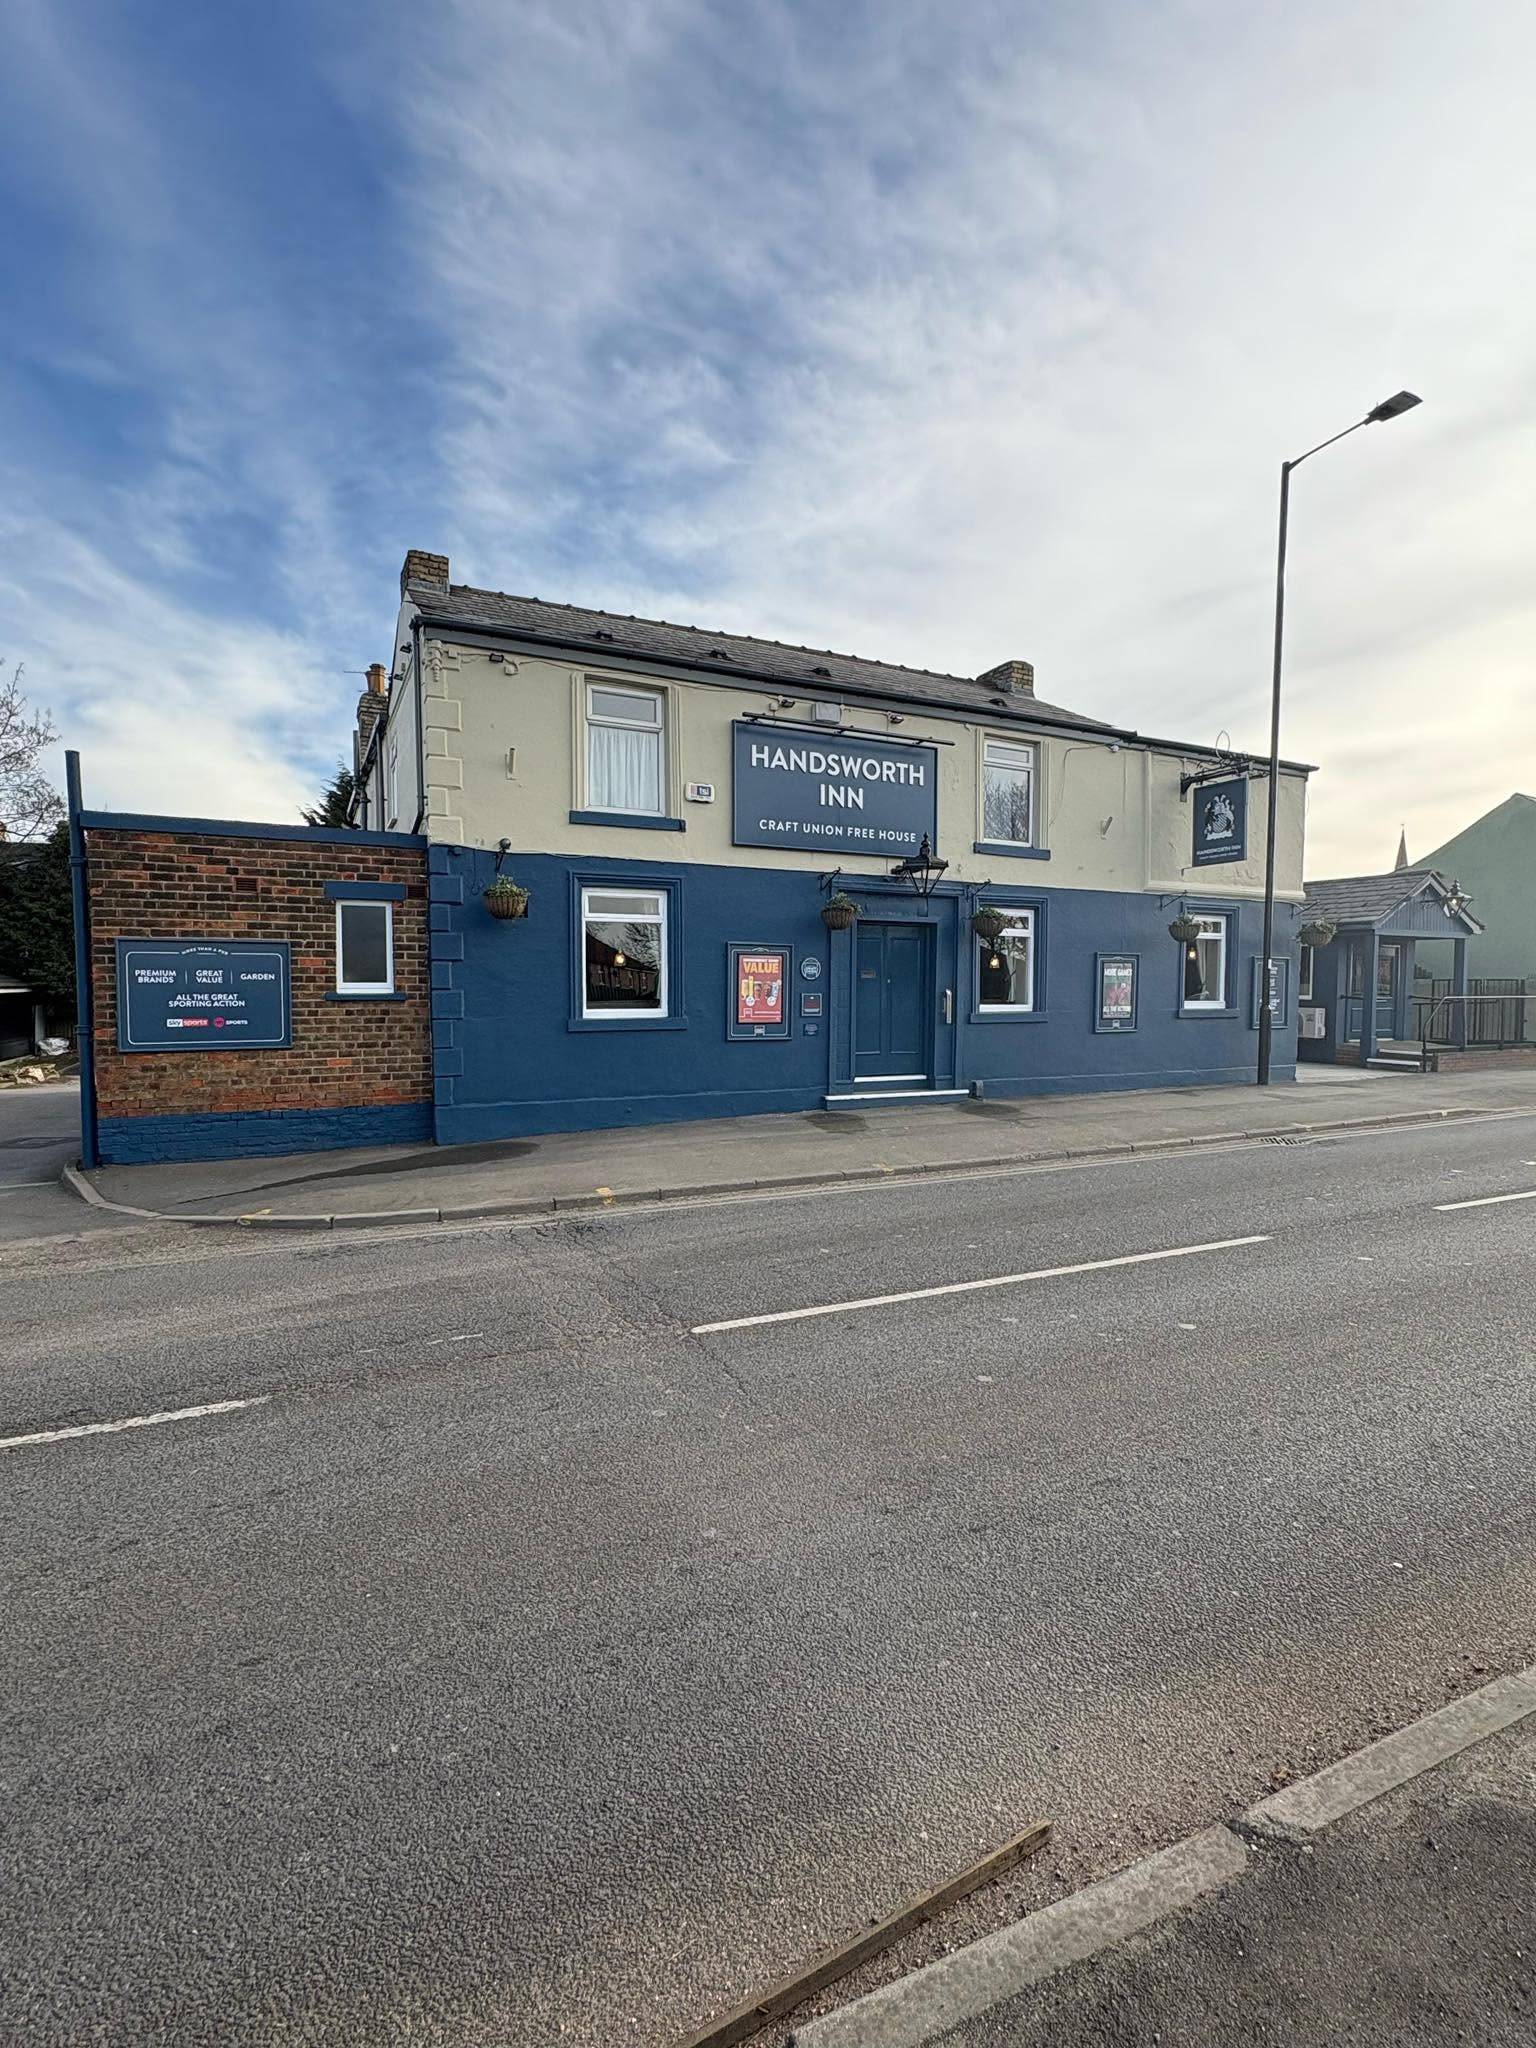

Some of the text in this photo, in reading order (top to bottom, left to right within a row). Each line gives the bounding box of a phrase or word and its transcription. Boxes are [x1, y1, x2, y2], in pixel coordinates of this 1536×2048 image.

[751, 744, 925, 786] HANDSWORTH
[820, 783, 864, 810] INN
[759, 819, 917, 843] CRAFT UNION FREE HOUSE
[744, 962, 779, 974] VALUE
[138, 976, 175, 984] BRANDS
[196, 976, 223, 984] VALUE
[240, 973, 275, 981] GARDEN
[211, 993, 238, 1001] GREAT
[168, 1000, 211, 1008] SPORTING
[168, 1019, 183, 1027] sky
[184, 1018, 208, 1027] sports
